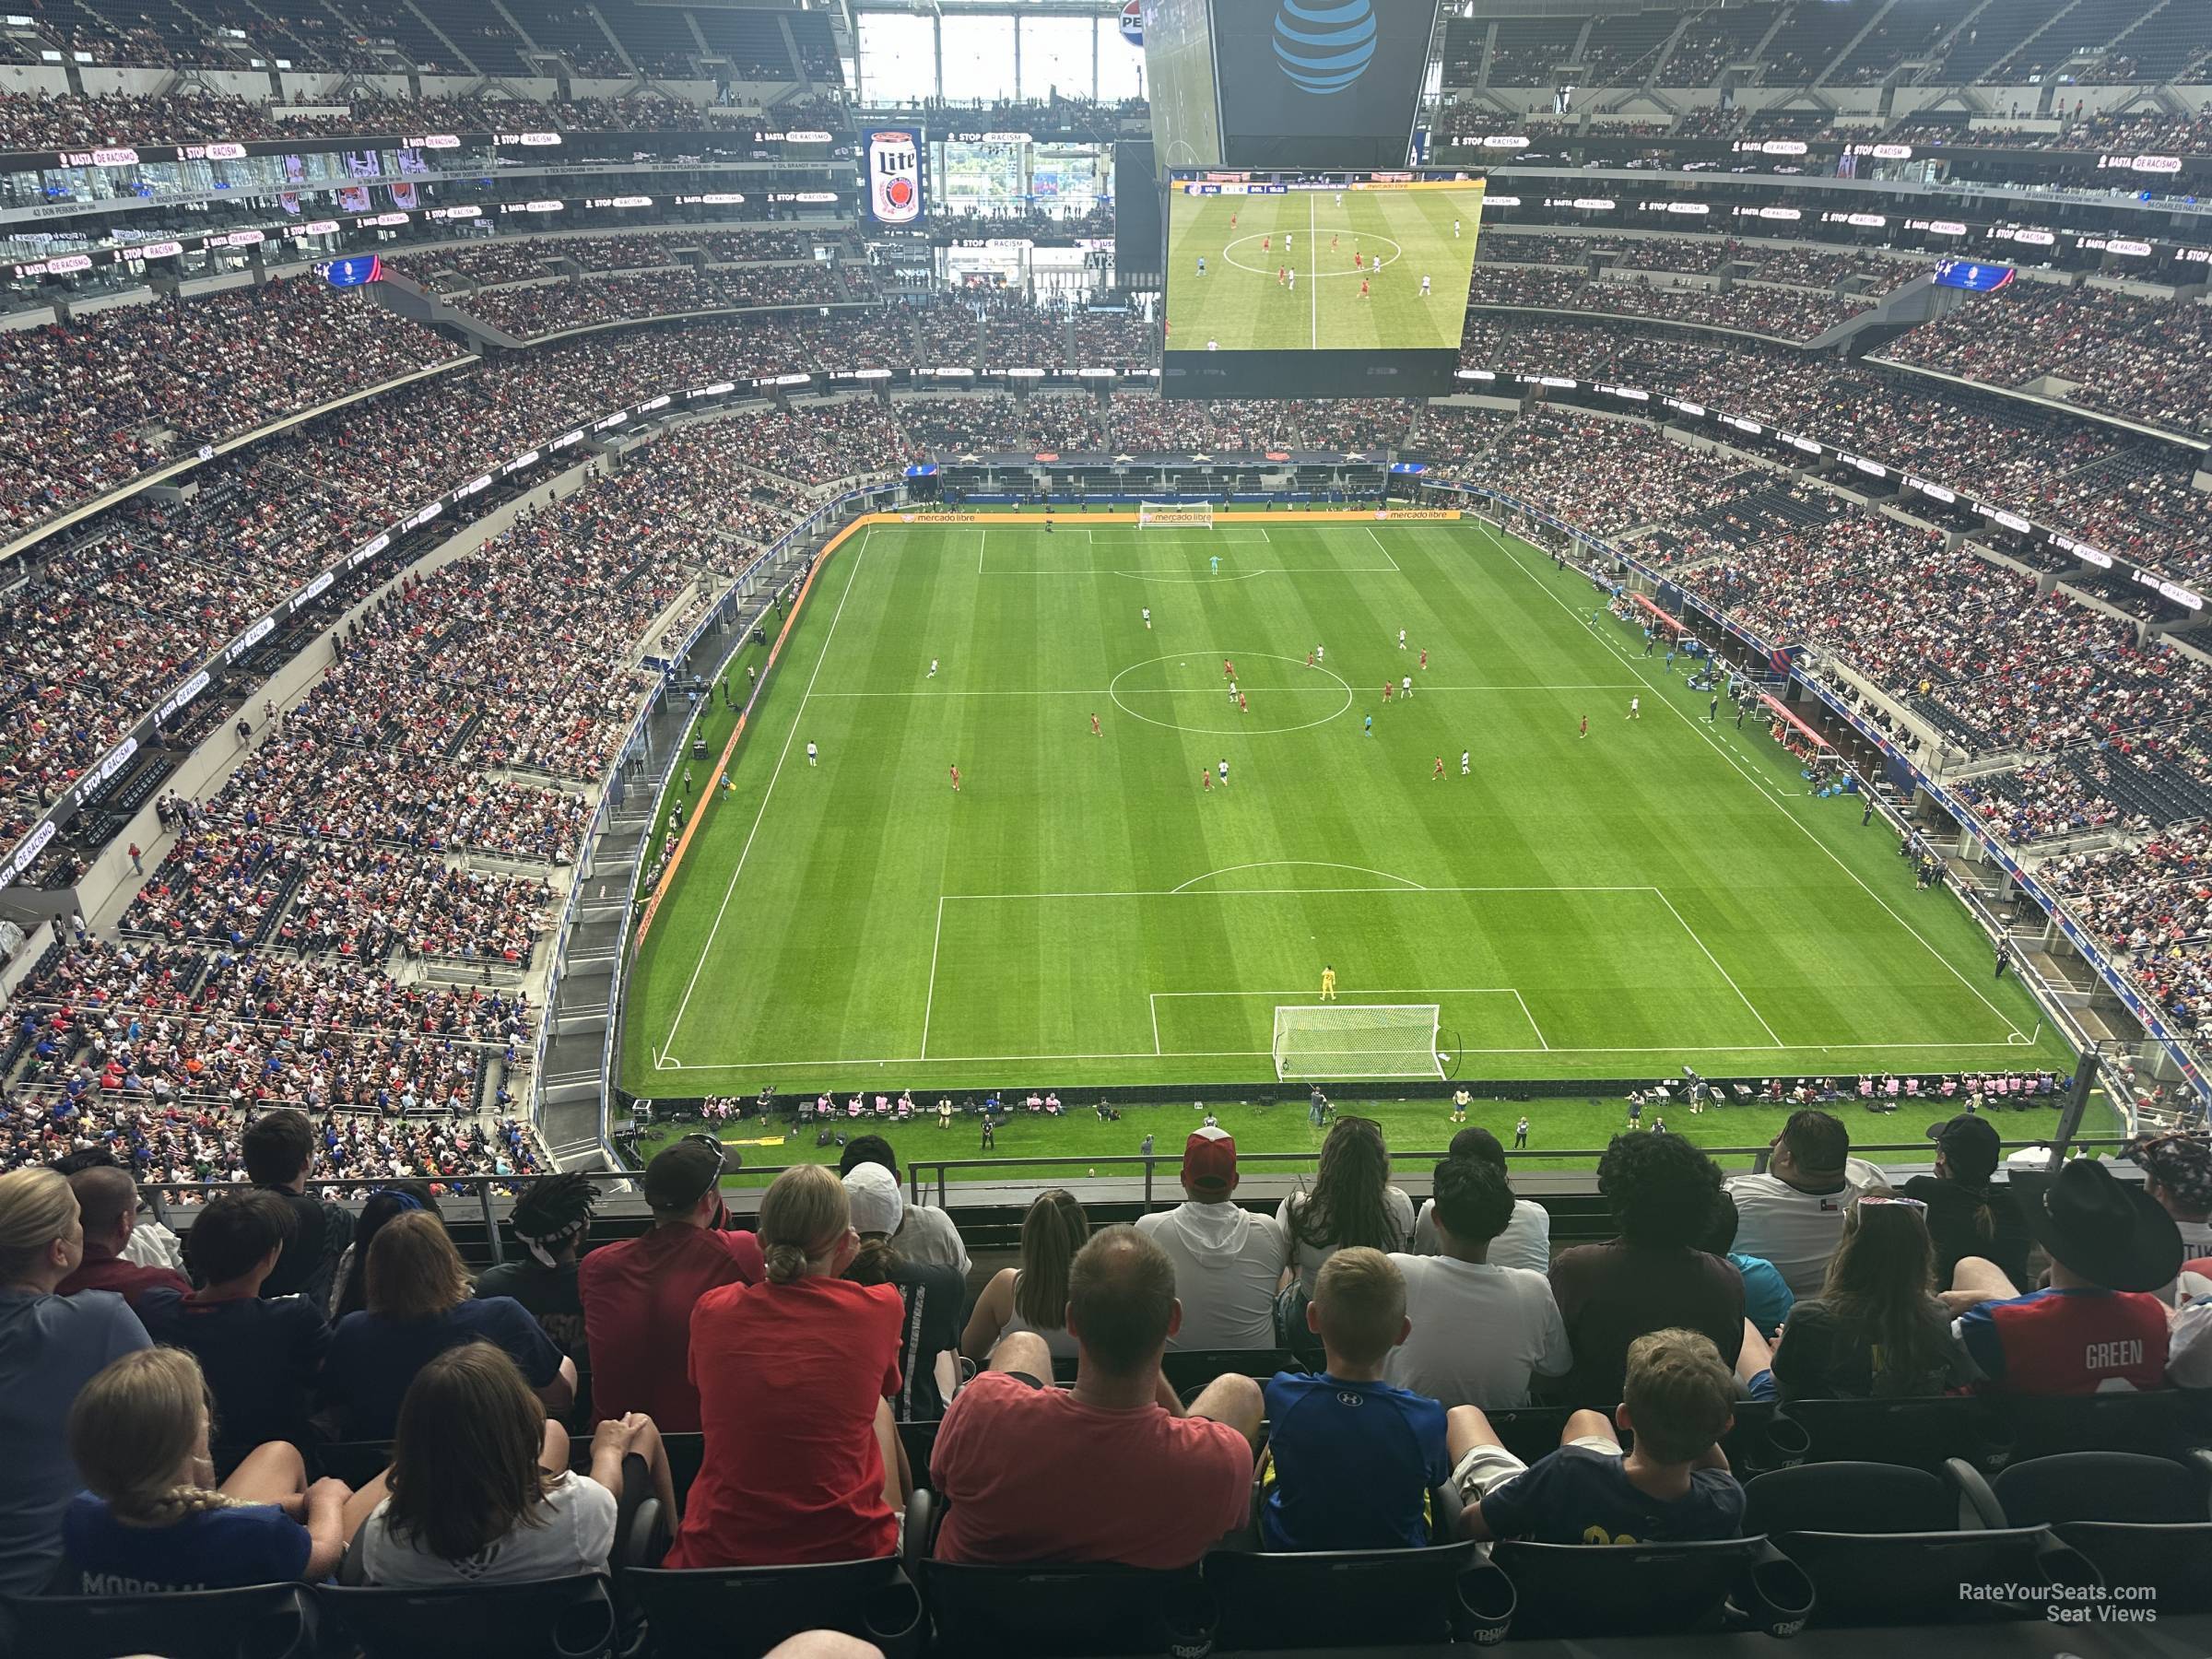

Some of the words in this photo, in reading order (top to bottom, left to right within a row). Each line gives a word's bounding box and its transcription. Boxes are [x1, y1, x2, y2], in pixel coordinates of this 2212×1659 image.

[1122, 17, 1142, 28] PE
[501, 135, 520, 145] STOP
[527, 135, 552, 144] RACISM
[765, 133, 785, 141] BASTA
[959, 133, 981, 141] STOP
[1463, 136, 1483, 146] STOP
[185, 147, 206, 159] STOP
[213, 147, 238, 157] RACISM
[1854, 145, 1874, 156] STOP
[1879, 146, 1903, 156] RACISM
[69, 153, 93, 166] BASTA
[96, 154, 107, 164] DE
[106, 151, 135, 163] RACISMO
[877, 150, 915, 176] Lite
[2108, 156, 2132, 168] BASTA
[2136, 159, 2145, 167] DE
[2146, 159, 2178, 170] RACISMO
[594, 198, 612, 207] STOP
[777, 194, 795, 202] STOP
[42, 207, 55, 216] DON
[55, 205, 78, 216] PERKINS
[1649, 203, 1668, 211] STOP
[431, 209, 447, 218] STOP
[1830, 213, 1848, 222] STOP
[290, 227, 306, 236] STOP
[1995, 228, 2015, 239] STOP
[2021, 233, 2046, 242] RACISM
[963, 239, 984, 247] STOP
[994, 240, 1023, 248] RACISM
[2085, 239, 2106, 249] BASTA
[2120, 242, 2147, 253] RACISMO
[123, 248, 143, 260] STOP
[149, 244, 174, 255] RACISM
[2186, 251, 2209, 262] STOP
[1085, 253, 1115, 269] AT&
[23, 264, 48, 276] BASTA
[60, 258, 88, 269] RACISMO
[1909, 479, 1924, 490] STOP
[956, 513, 975, 522] libre
[1155, 513, 1193, 522] mercado
[1193, 512, 1212, 522] libre
[1390, 511, 1428, 519] mercado
[1428, 510, 1447, 519] libre
[2055, 536, 2075, 551] STOP
[2140, 574, 2160, 590] BASTA
[231, 639, 246, 658] STOP
[249, 623, 269, 641] RACISM
[160, 699, 178, 720] BASTA
[179, 691, 188, 702] DE
[186, 674, 208, 697] RACISMO
[83, 771, 102, 796] STOP
[107, 745, 131, 772] RACISM
[0, 865, 17, 891] ASTA
[18, 852, 29, 867] DE
[27, 822, 53, 861] RACISMO
[2086, 1338, 2143, 1370] GREEN
